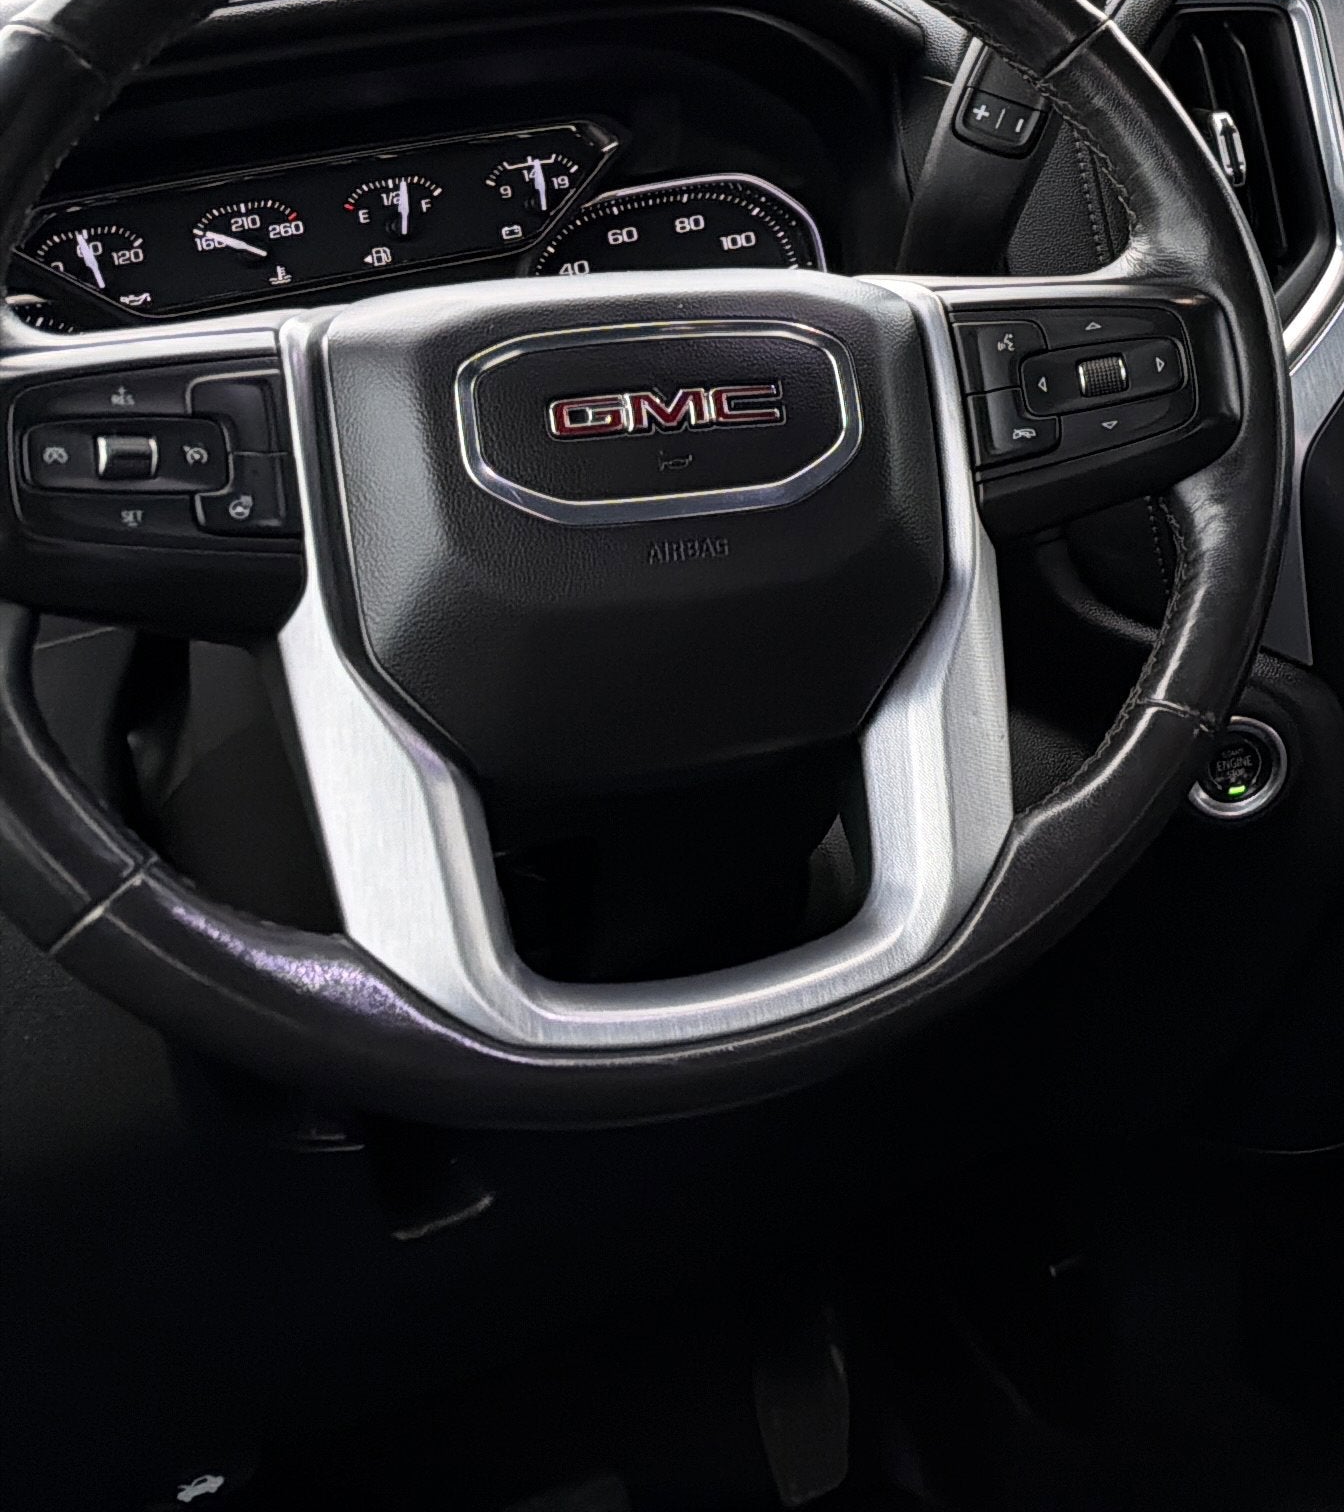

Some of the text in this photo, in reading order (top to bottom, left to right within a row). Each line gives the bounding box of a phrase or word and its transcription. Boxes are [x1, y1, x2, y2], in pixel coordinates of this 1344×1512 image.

[551, 175, 570, 189] 19
[500, 185, 512, 199] 9
[420, 199, 432, 213] F
[230, 214, 261, 232] 210
[358, 209, 370, 224] E
[675, 214, 705, 233] 80
[268, 221, 304, 239] 260
[607, 226, 638, 245] 60
[195, 237, 229, 251] 160
[719, 231, 757, 251] 100
[111, 248, 144, 266] 120
[559, 260, 590, 275] 40
[546, 383, 785, 439] GMC
[120, 509, 145, 523] SET
[647, 538, 730, 565] AIRBAG
[1216, 755, 1252, 772] ENGINE
